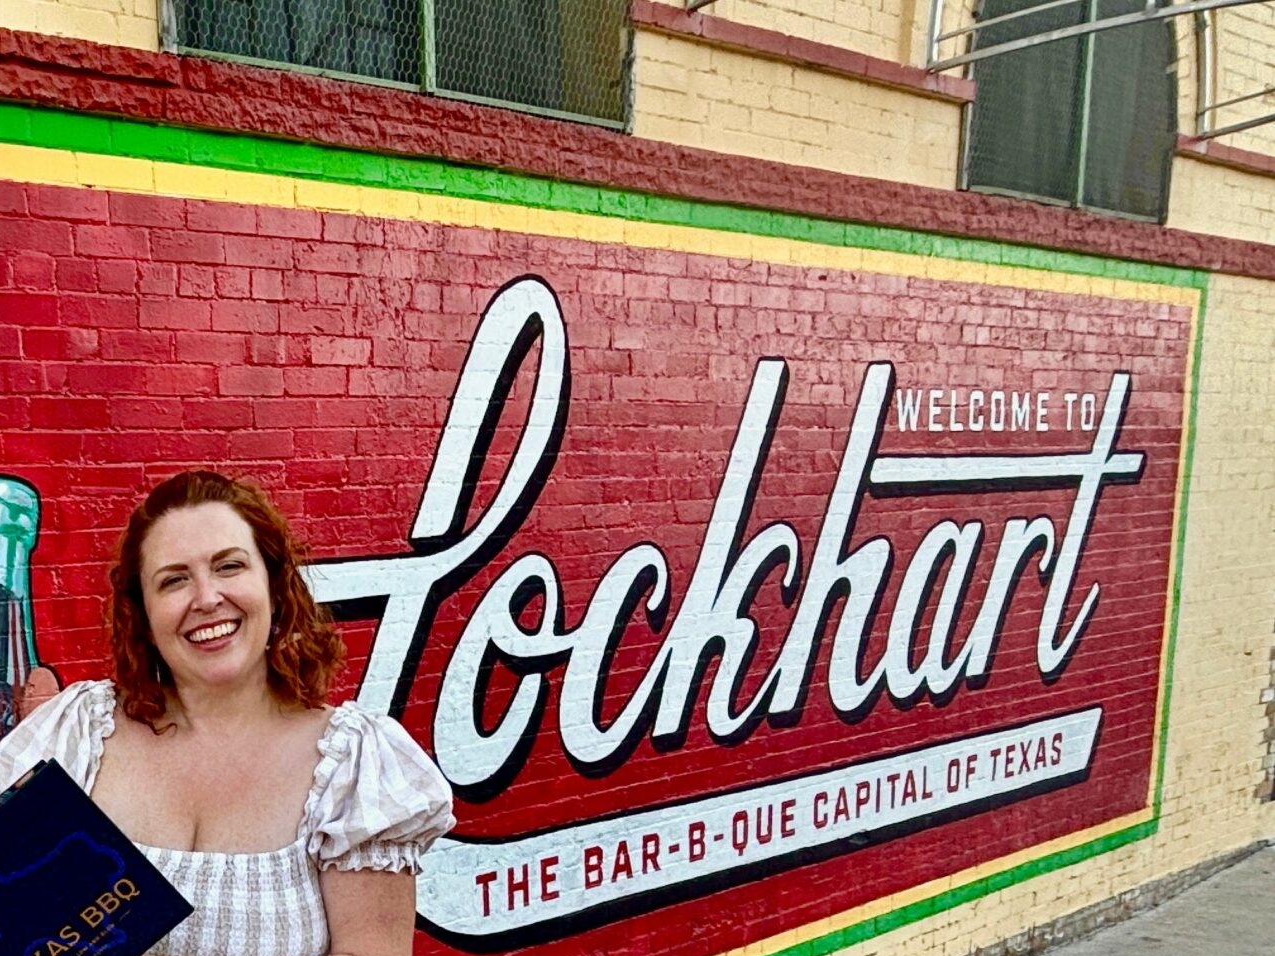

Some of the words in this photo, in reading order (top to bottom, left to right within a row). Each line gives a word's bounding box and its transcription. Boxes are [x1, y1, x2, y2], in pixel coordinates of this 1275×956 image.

[896, 387, 1050, 432] WELCOME
[1064, 392, 1096, 431] TO
[298, 274, 1145, 792] Lockhart
[475, 855, 560, 917] THE
[584, 798, 798, 891] BAR-B-QUE
[812, 769, 933, 829] CAPITAL
[946, 752, 978, 795] OF
[989, 732, 1064, 782] TEXAS
[79, 877, 141, 928] BBQ
